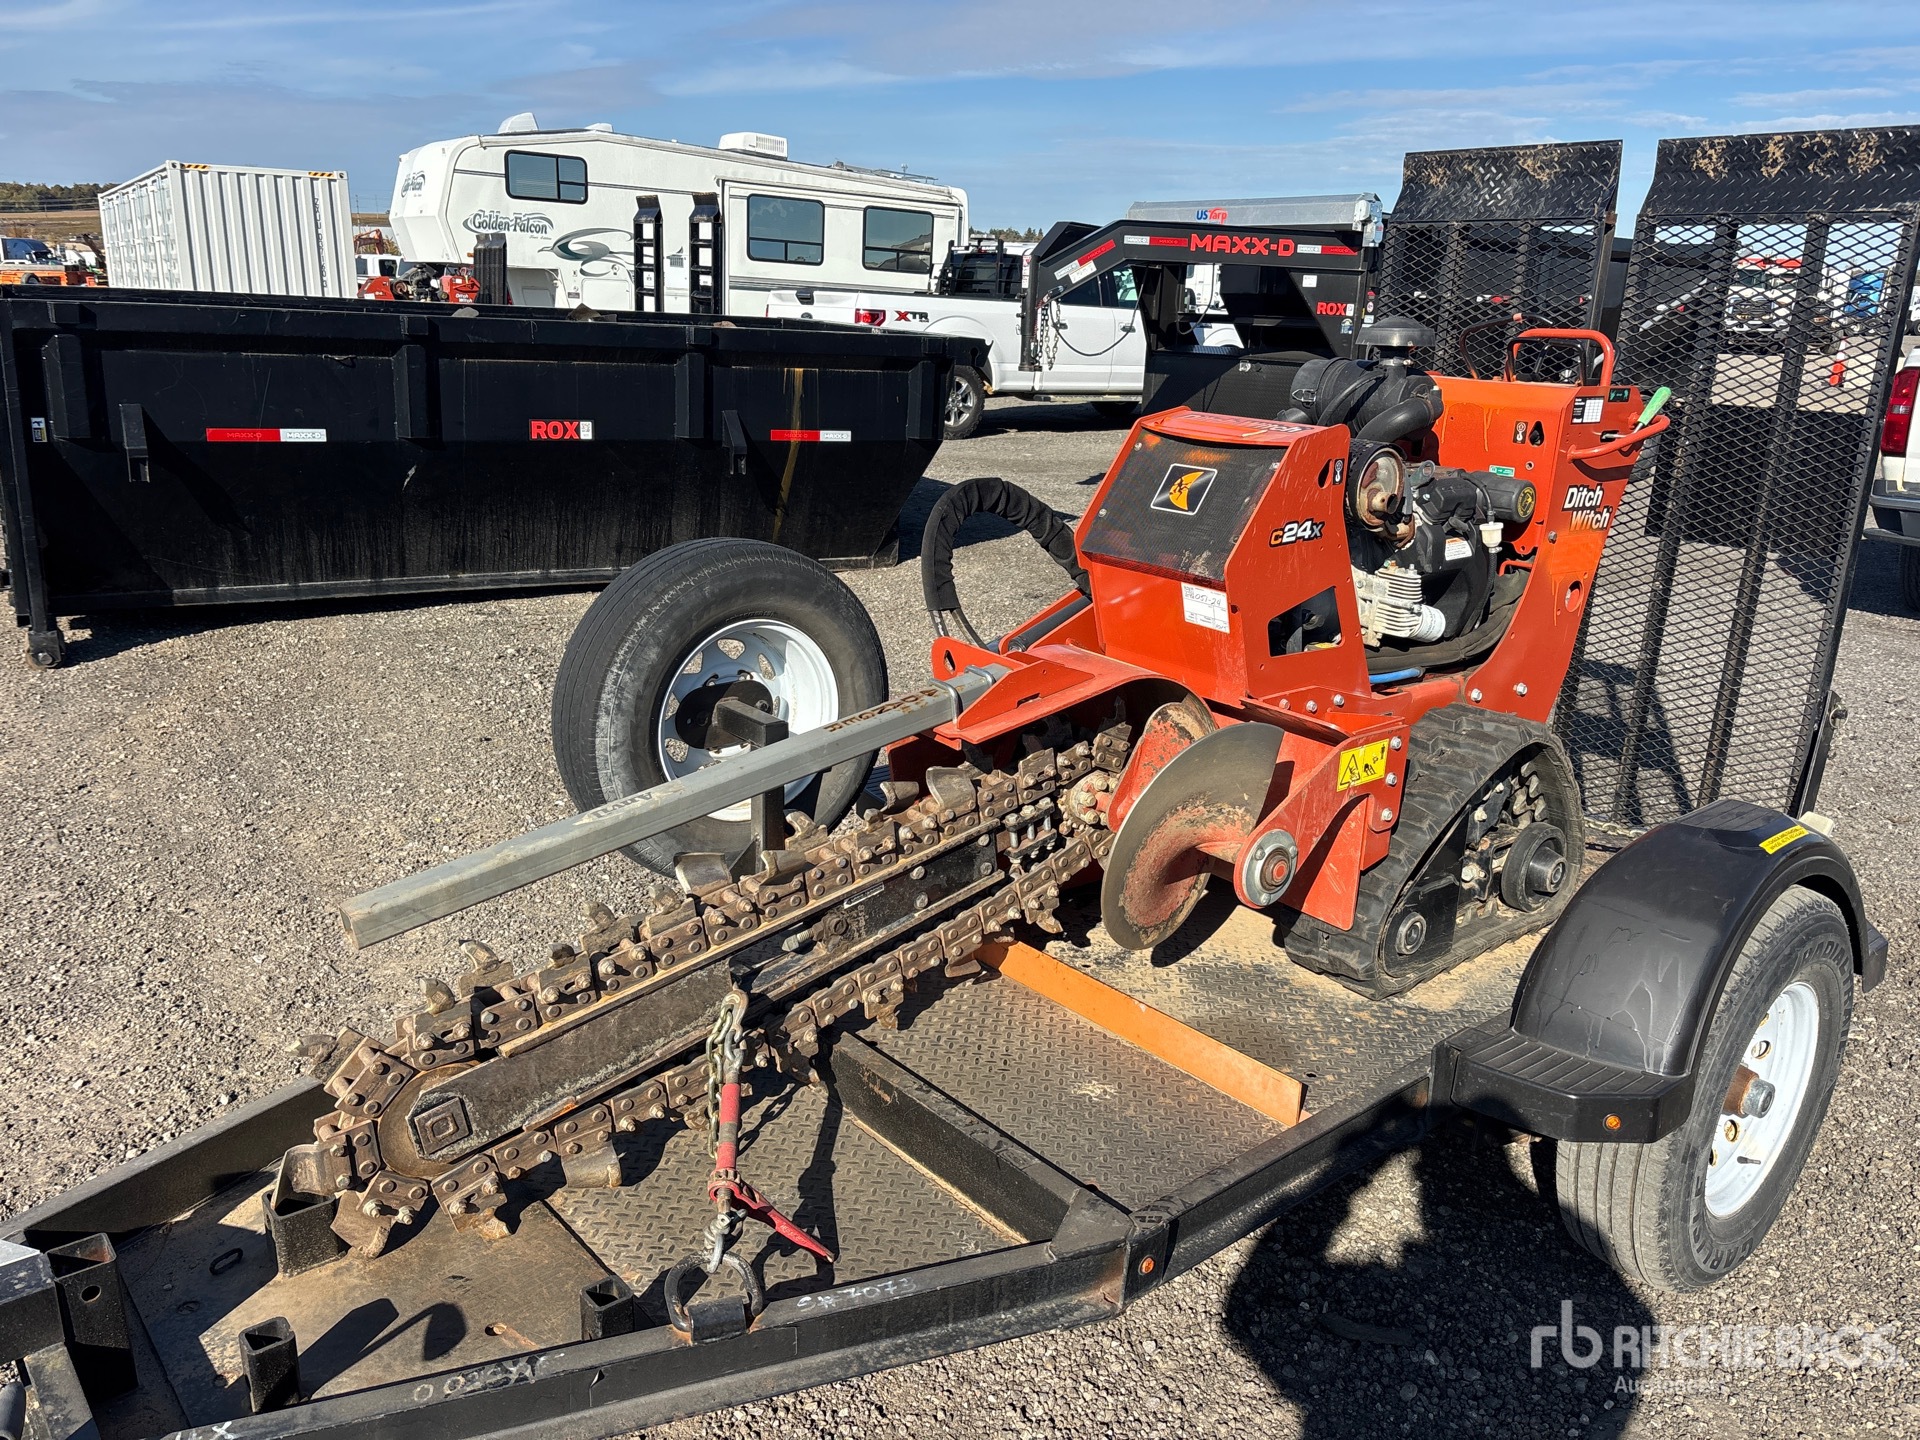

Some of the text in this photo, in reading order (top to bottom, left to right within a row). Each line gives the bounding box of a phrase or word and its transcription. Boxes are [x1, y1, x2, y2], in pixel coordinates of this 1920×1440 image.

[1190, 233, 1295, 257] MAXX-D
[894, 310, 930, 322] XTR
[1316, 301, 1347, 315] ROX
[530, 420, 580, 440] ROX
[1563, 485, 1604, 509] Ditch
[1569, 507, 1610, 531] Witch
